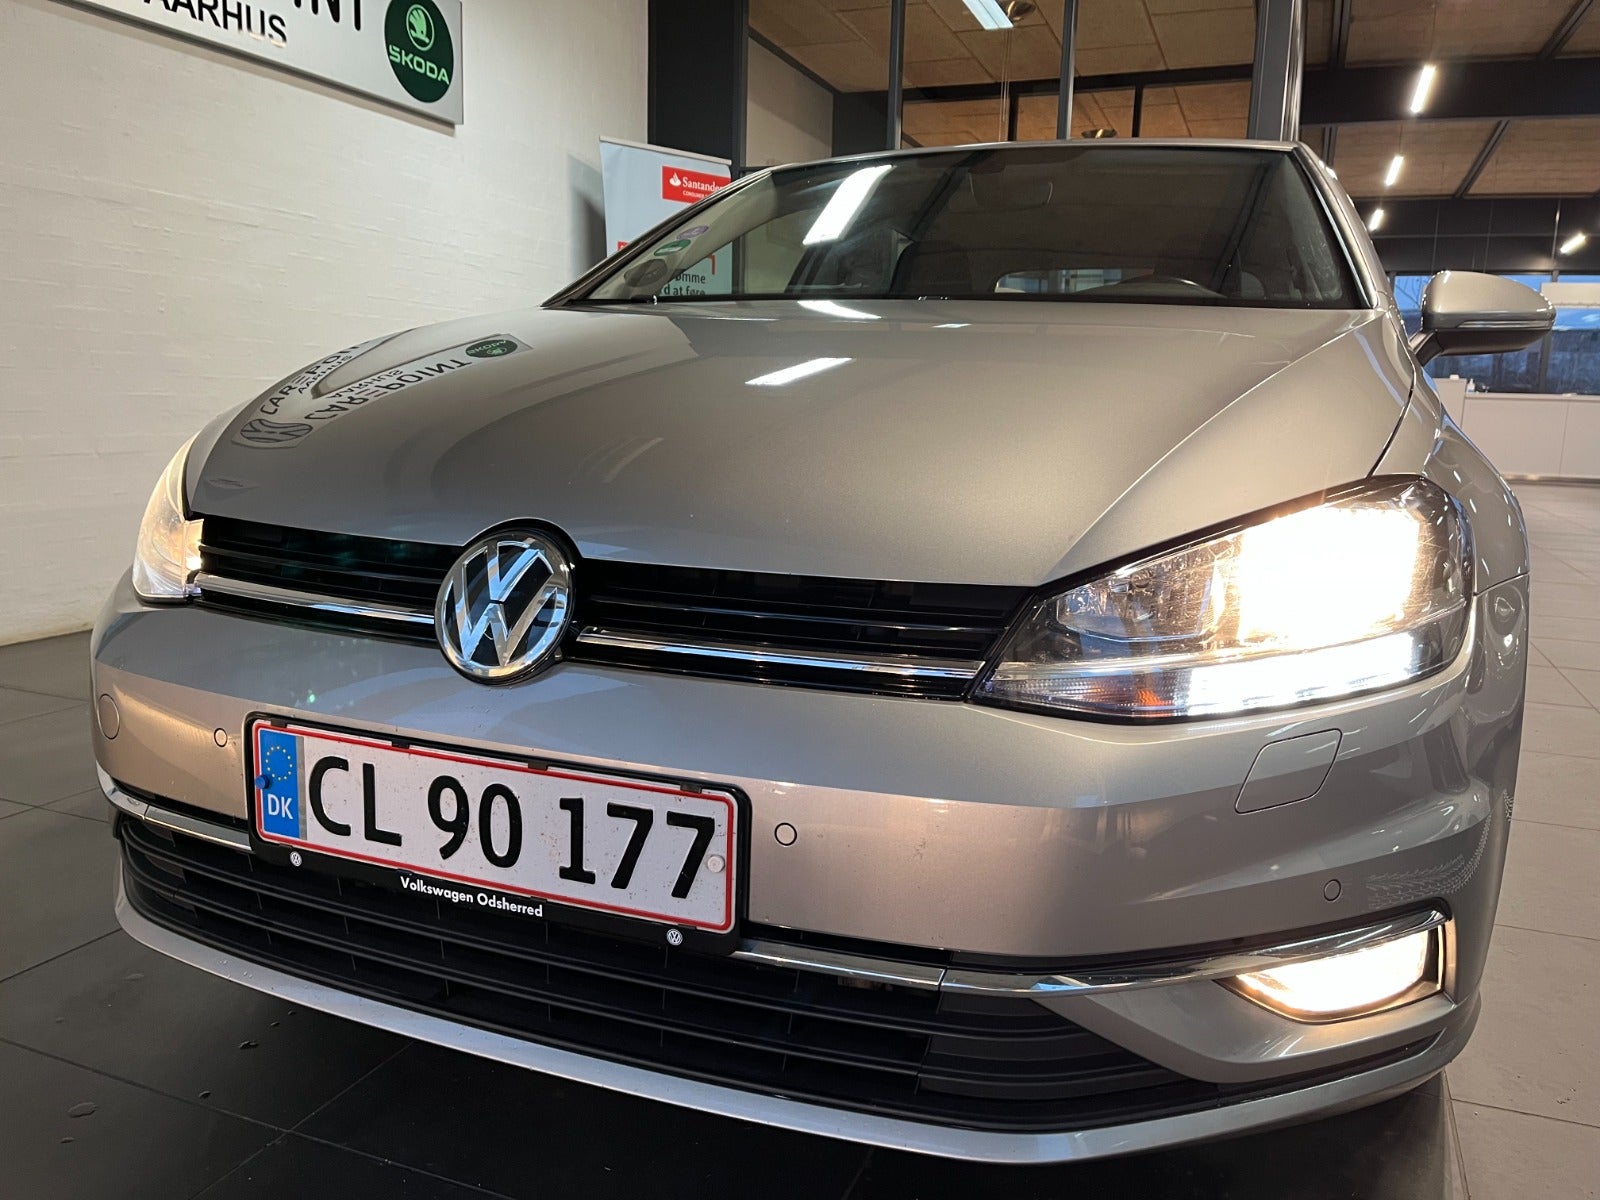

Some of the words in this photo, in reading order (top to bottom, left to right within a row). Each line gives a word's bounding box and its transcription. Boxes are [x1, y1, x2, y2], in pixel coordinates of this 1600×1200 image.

[143, 0, 288, 48] ARHUS
[388, 44, 450, 85] SKODA
[267, 793, 294, 820] DK
[308, 755, 402, 847] CL
[427, 775, 523, 868] 90
[559, 797, 716, 900] 177
[400, 876, 474, 903] Volkswagen
[477, 893, 543, 917] Odsherred
